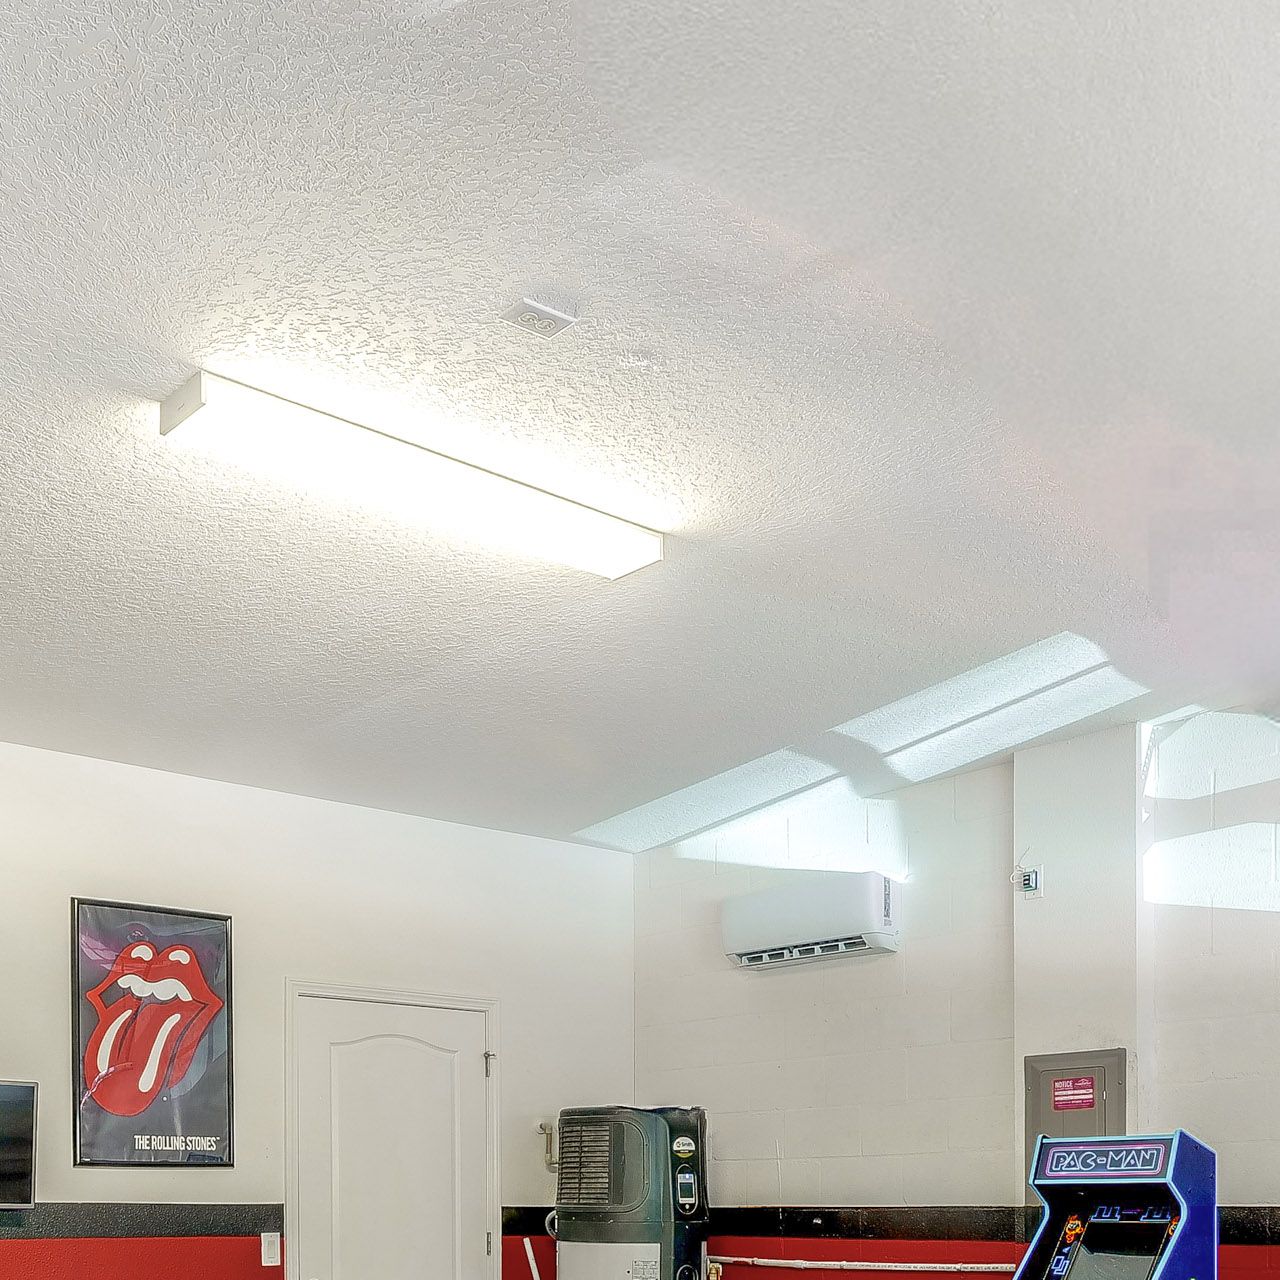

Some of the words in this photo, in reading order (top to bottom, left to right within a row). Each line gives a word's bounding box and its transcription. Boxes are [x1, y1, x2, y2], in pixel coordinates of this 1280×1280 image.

[1054, 1080, 1074, 1088] NOTICE
[134, 1135, 151, 1150] THE
[151, 1135, 186, 1150] ROLLING
[186, 1136, 217, 1151] STONES
[1051, 1149, 1157, 1171] PAC-MAN
